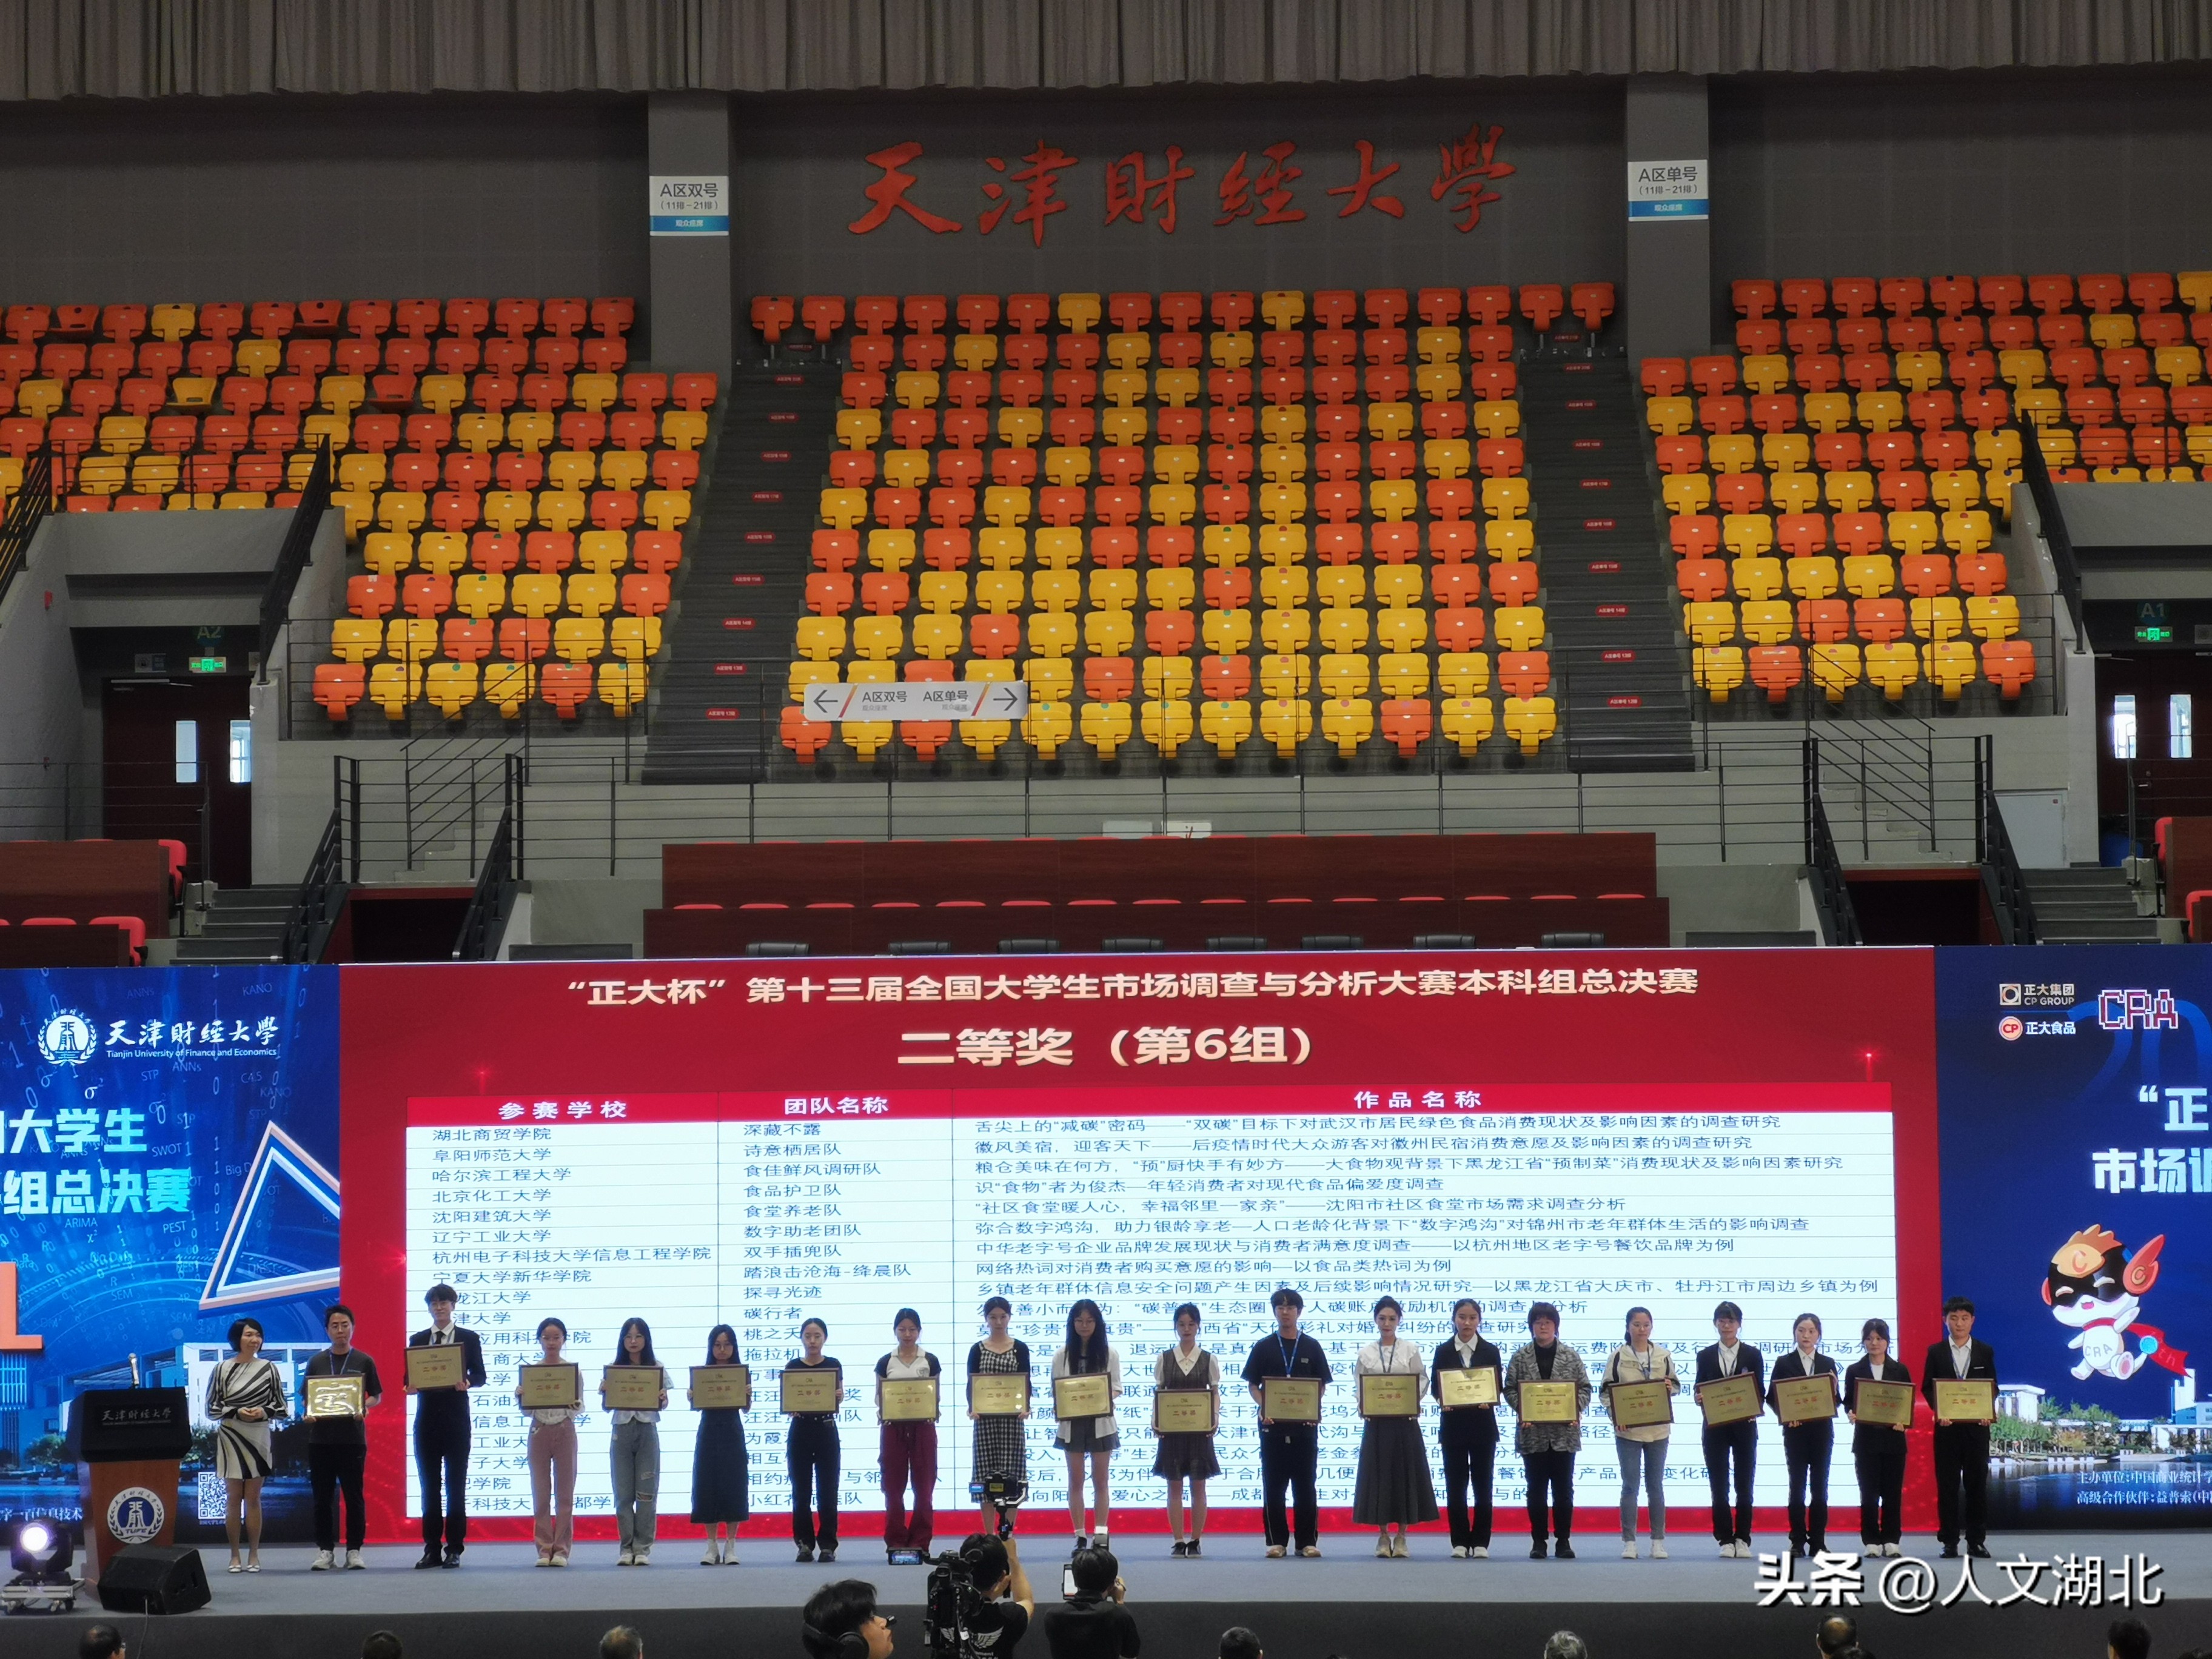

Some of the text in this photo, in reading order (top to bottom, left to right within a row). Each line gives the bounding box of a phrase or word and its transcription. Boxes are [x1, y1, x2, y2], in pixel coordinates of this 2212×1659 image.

[1638, 166, 1698, 182] A区单号
[660, 183, 719, 198] A区双号
[2140, 603, 2165, 617] A1
[862, 690, 968, 703] A区双号 A区单号
[2024, 984, 2074, 996] 正大集团
[2098, 989, 2179, 1030] CRA
[2002, 1024, 2019, 1033] CP
[2025, 1022, 2076, 1034] 正大食品
[107, 1050, 133, 1059] Tianjin
[134, 1050, 173, 1058] University
[172, 1062, 201, 1072] ANNs
[141, 1069, 159, 1081] STP
[785, 1097, 889, 1114] 团队名称
[1354, 1090, 1482, 1109] 作品名称
[499, 1101, 627, 1120] 参赛学校
[0, 1108, 147, 1154] 大学生
[434, 1128, 551, 1141] 湖北商贸学院
[744, 1124, 820, 1136] 深藏不露
[152, 1143, 182, 1158] SWOT
[434, 1148, 551, 1162] 阜阳师范大学
[744, 1143, 841, 1157] 诗意栖居队
[432, 1168, 571, 1182] 哈尔滨工程大学
[744, 1163, 880, 1177] 食佳鲜风调研队
[4, 1168, 190, 1215] 组总决赛
[432, 1189, 551, 1202] 北京化工大学
[744, 1184, 841, 1197] 食品护卫队
[433, 1209, 551, 1223] 沈阳建筑大学
[744, 1204, 841, 1218] 食堂养老队
[65, 1216, 98, 1228] ARIMA
[163, 1220, 187, 1233] PEST
[433, 1228, 551, 1243] 辽宁工业大学
[745, 1224, 861, 1238] 数字助老团队
[433, 1247, 711, 1264] 杭州电子科技大学信息工程学院
[745, 1244, 841, 1258] 双手插兜队
[434, 1269, 591, 1284] 宁夏大学新华学院
[111, 1289, 133, 1301] SEM
[457, 1292, 531, 1305] 龙江大学
[744, 1284, 822, 1299] 探寻光迹
[452, 1312, 511, 1325] 津大学
[744, 1304, 802, 1319] 碳行者
[2085, 1344, 2113, 1358] CRA
